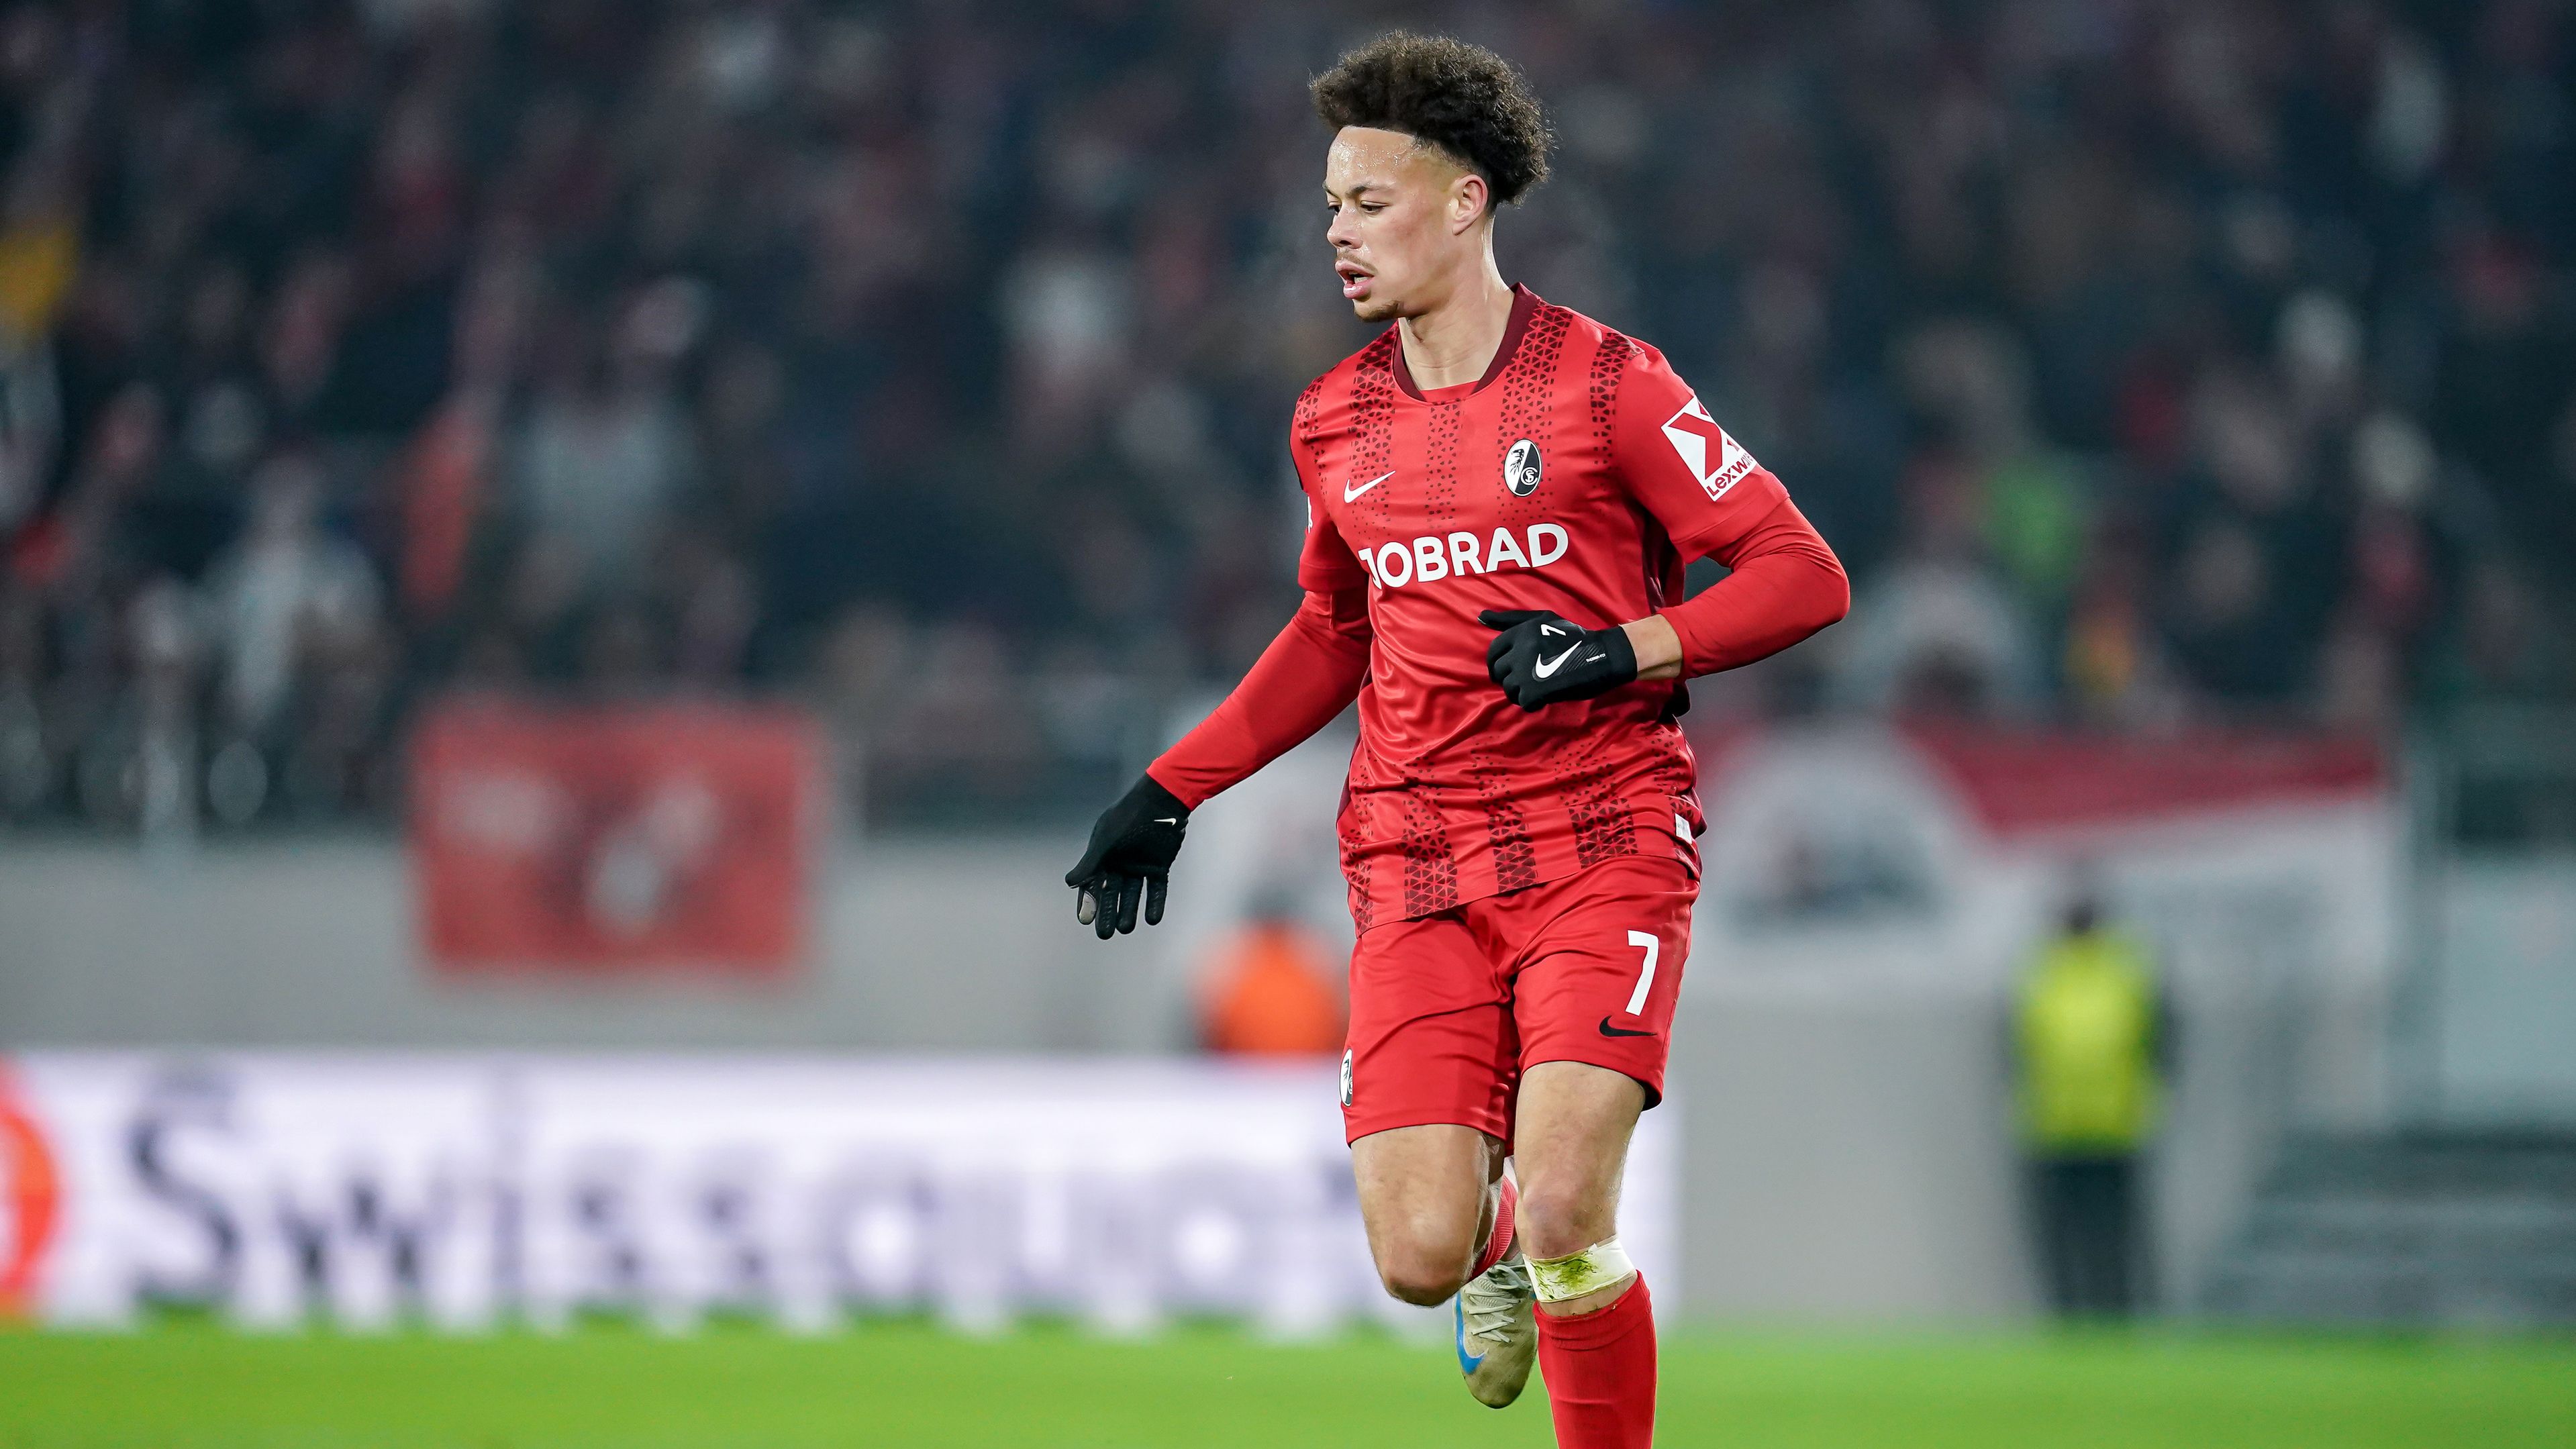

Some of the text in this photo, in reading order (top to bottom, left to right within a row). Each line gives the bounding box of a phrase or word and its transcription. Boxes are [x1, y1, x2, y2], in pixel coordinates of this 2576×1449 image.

[1357, 523, 1569, 590] JOBRAD
[1541, 623, 1567, 636] 7
[1625, 929, 1660, 1016] 7
